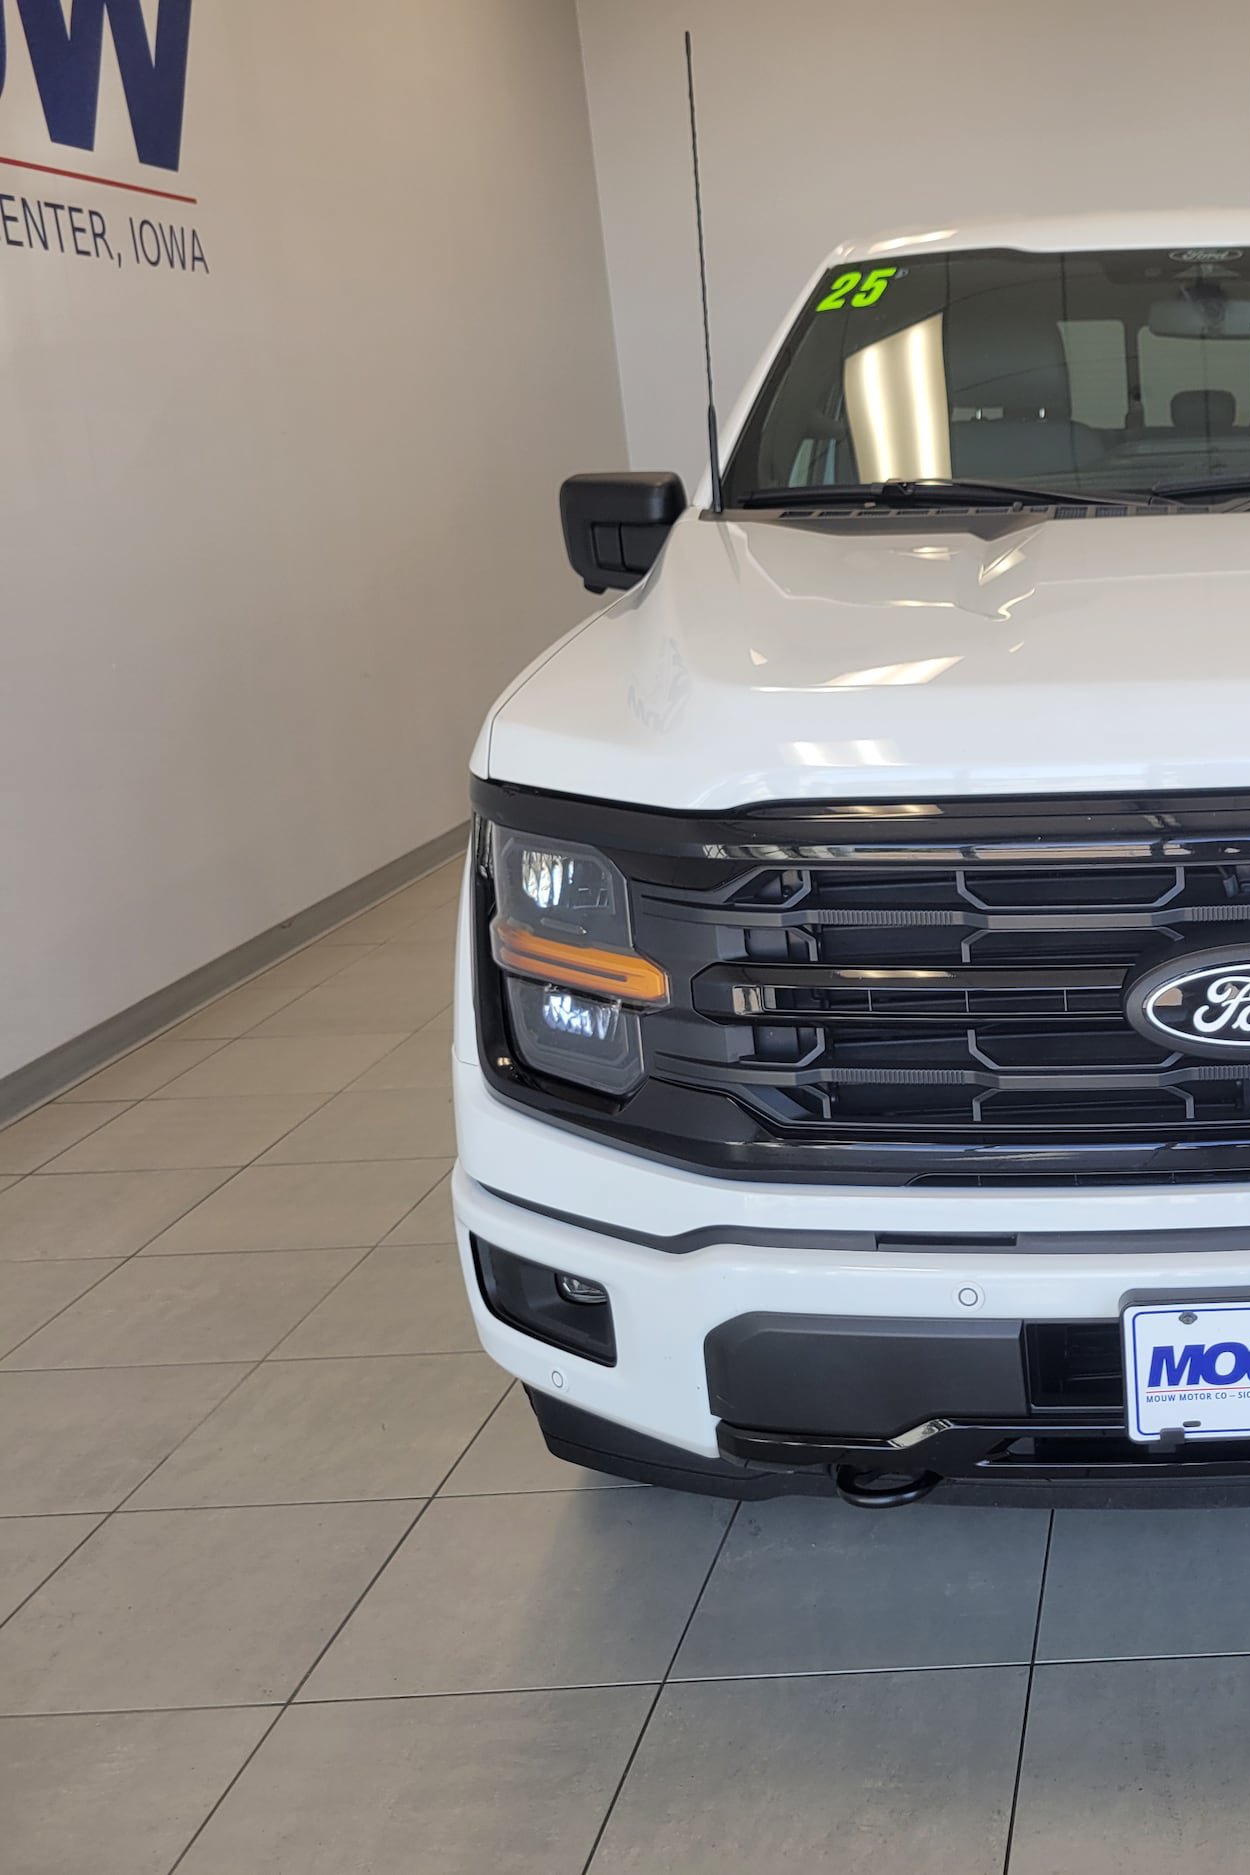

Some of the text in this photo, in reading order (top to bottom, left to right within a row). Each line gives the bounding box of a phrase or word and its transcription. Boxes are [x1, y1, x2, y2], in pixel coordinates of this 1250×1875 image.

[0, 0, 192, 173] W
[0, 193, 210, 274] ENTER, IOWA
[815, 267, 898, 312] 25
[1145, 1393, 1177, 1404] MOUW
[1178, 1391, 1213, 1402] MOTOR
[1215, 1390, 1228, 1400] CO
